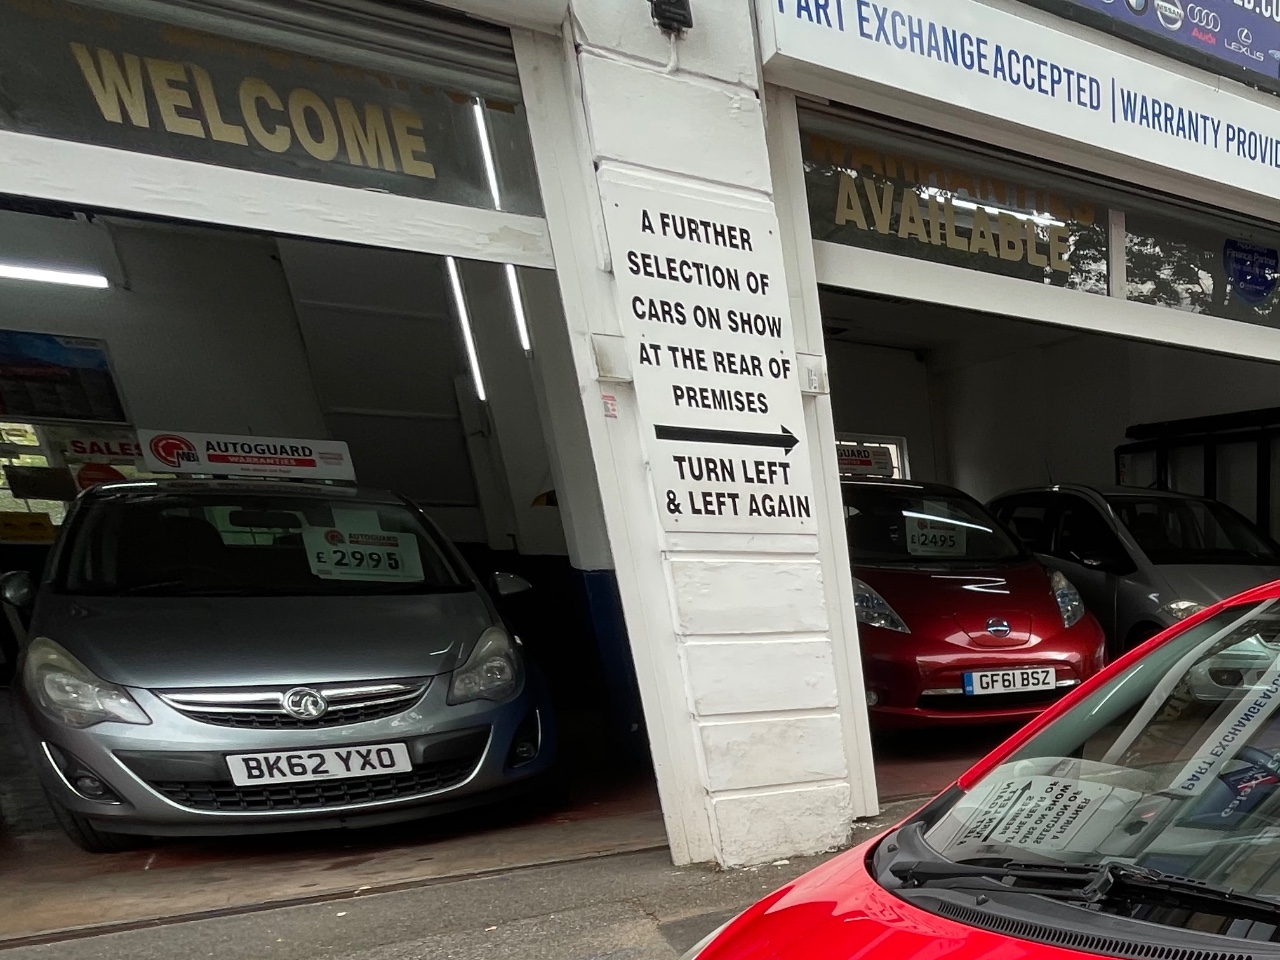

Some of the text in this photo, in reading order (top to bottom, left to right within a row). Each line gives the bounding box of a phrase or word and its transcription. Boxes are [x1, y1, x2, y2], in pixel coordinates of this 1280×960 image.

[1156, 2, 1183, 20] NISSAN
[1191, 27, 1216, 45] Audi
[1224, 38, 1264, 62] LEXUS
[70, 42, 436, 179] WELCOME
[993, 45, 1101, 111] ACCEPTED
[1120, 87, 1221, 149] WARRANTY
[641, 209, 753, 252] A FURTHER
[834, 172, 1071, 273] AVAILABLE
[1227, 248, 1276, 266] Finance Partner
[627, 250, 770, 296] SELECTION OF
[632, 296, 782, 339] CARS ON SHOW
[639, 342, 791, 380] AT THE REAR OF
[672, 385, 769, 414] PREMISES
[205, 440, 313, 458] AUTOGUARD
[227, 456, 297, 466] WARRANTIES
[673, 455, 790, 486] TURN LEFT
[666, 490, 811, 518] & LEFT AGAIN
[979, 669, 1051, 691] GF61 BSZ
[242, 747, 397, 780] BK62 YXO
